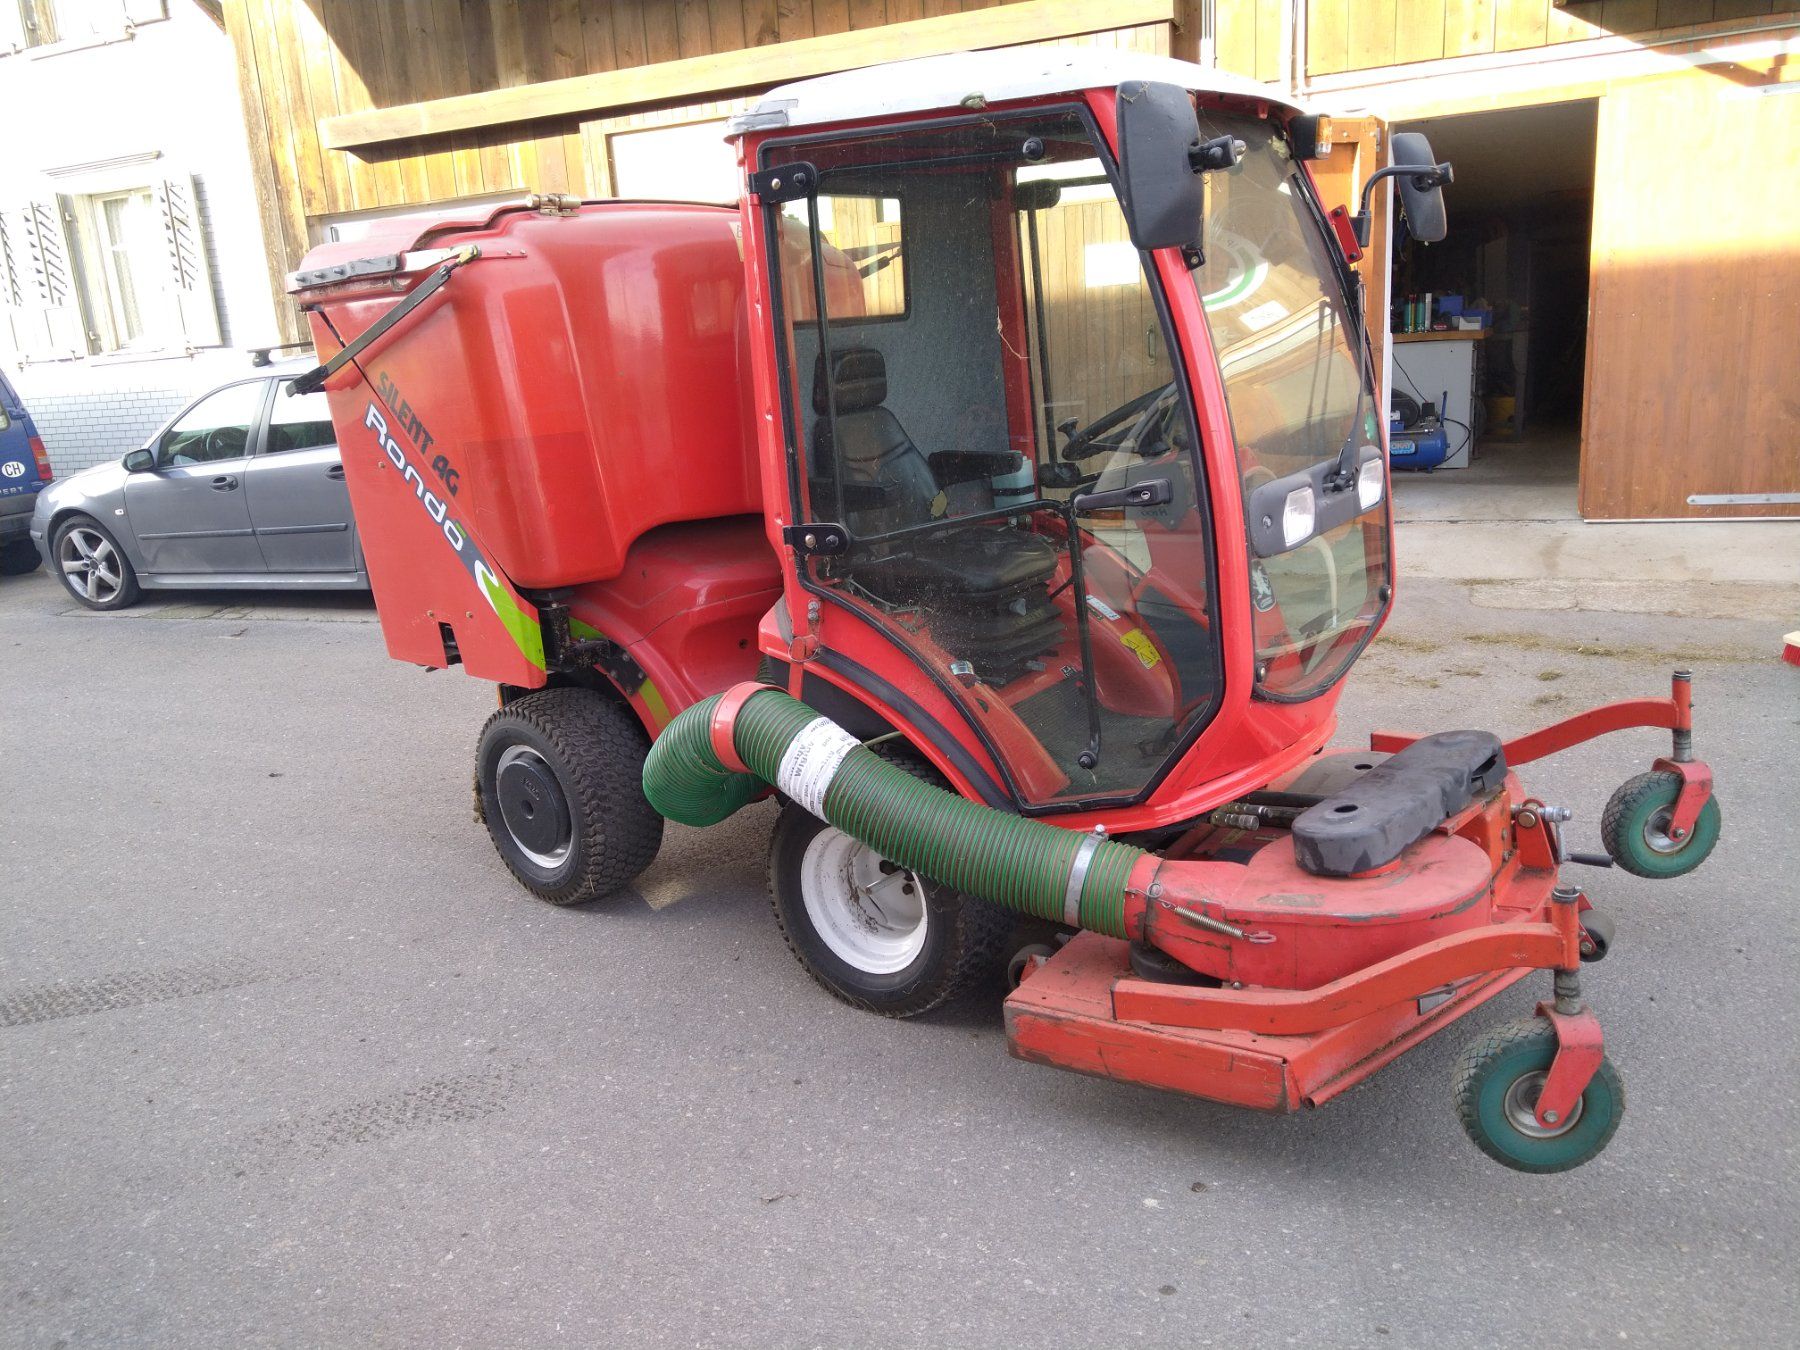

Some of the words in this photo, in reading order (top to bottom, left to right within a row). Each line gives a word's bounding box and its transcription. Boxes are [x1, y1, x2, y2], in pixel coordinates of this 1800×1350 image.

[376, 371, 434, 455] SILENT
[431, 454, 460, 497] AG
[4, 462, 21, 476] CH
[0, 487, 23, 495] ERT
